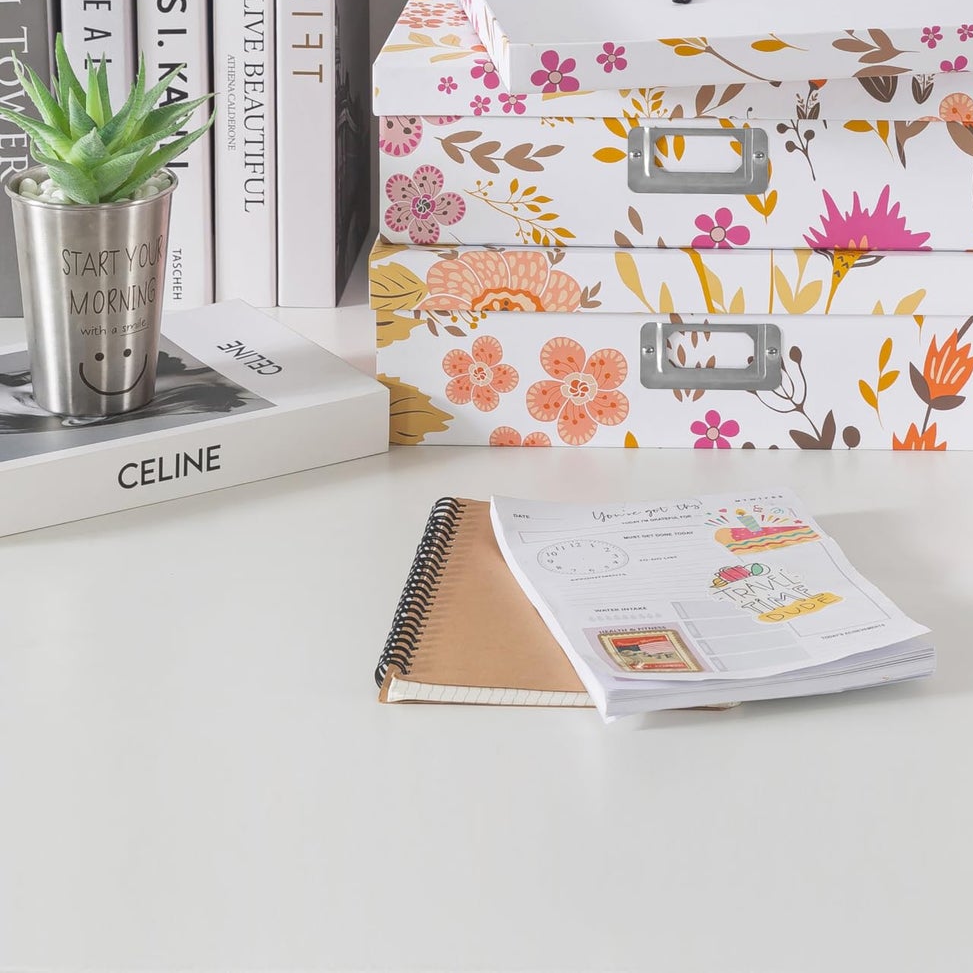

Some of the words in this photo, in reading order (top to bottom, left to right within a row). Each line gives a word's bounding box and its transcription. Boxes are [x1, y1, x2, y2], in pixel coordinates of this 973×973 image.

[156, 28, 188, 47] I.
[157, 62, 190, 169] KA
[243, 62, 266, 213] BEAUTIFUL
[62, 249, 120, 277] START
[125, 234, 163, 272] YOUR
[70, 277, 157, 316] MORNING
[80, 325, 107, 336] with
[111, 327, 118, 335] a
[217, 340, 283, 376] CELINE
[118, 444, 221, 490] CELINE
[713, 570, 801, 602] TRAVEL
[741, 585, 825, 614] TIME
[767, 596, 838, 622] DUDE
